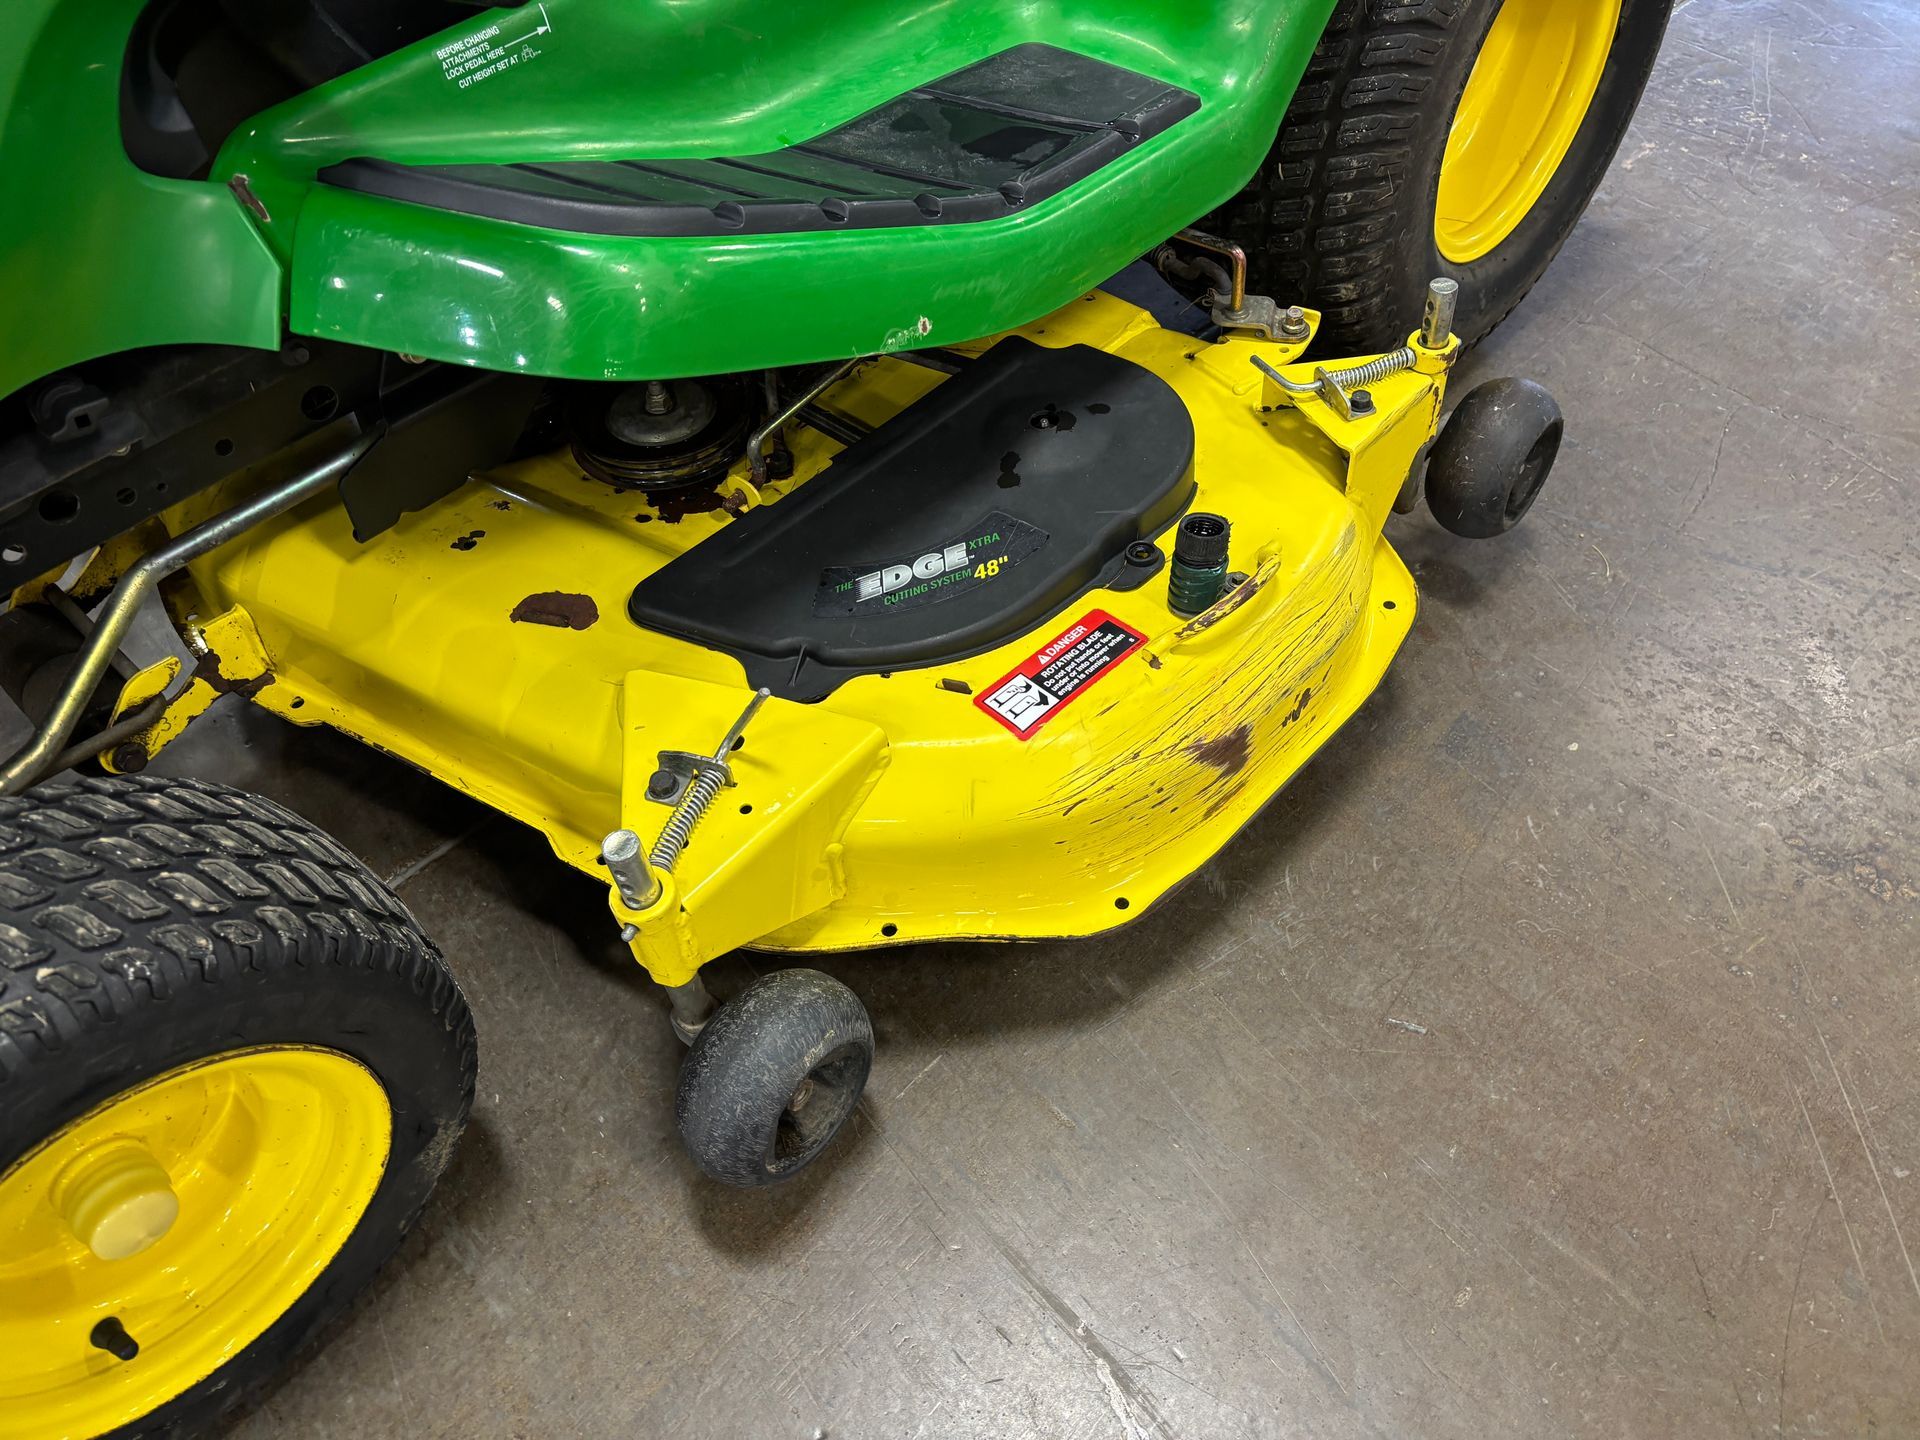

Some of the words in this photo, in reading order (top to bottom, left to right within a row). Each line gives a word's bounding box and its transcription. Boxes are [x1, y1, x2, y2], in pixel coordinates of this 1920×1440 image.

[437, 41, 465, 59] BEFORE
[464, 26, 500, 47] CHANGING
[442, 42, 490, 70] ATTACHMENTS
[445, 66, 465, 80] LOCK
[465, 58, 487, 71] PEDAL
[486, 47, 505, 60] HERE
[459, 76, 473, 88] CUT
[473, 66, 497, 82] HEIGHT
[496, 60, 509, 71] SET
[510, 55, 518, 64] AT
[835, 580, 854, 593] THE
[856, 543, 969, 603] EDGE
[968, 532, 1000, 550] XTRA
[884, 583, 928, 605] CUTTING
[930, 568, 972, 589] SYSTEM
[974, 556, 1008, 579] 48"
[1041, 648, 1079, 678] ROTATING
[1077, 630, 1103, 651] BLADE
[1044, 678, 1055, 687] Do
[1054, 670, 1067, 680] not
[1065, 661, 1077, 672] put
[1075, 648, 1095, 663] hands
[1100, 633, 1114, 643] feet
[1045, 625, 1088, 656] DANGER
[1051, 676, 1070, 691] under
[1076, 661, 1090, 672] into
[1090, 646, 1109, 662] mower
[1108, 634, 1125, 647] when
[1058, 678, 1079, 696] engine
[1085, 655, 1110, 675] running
